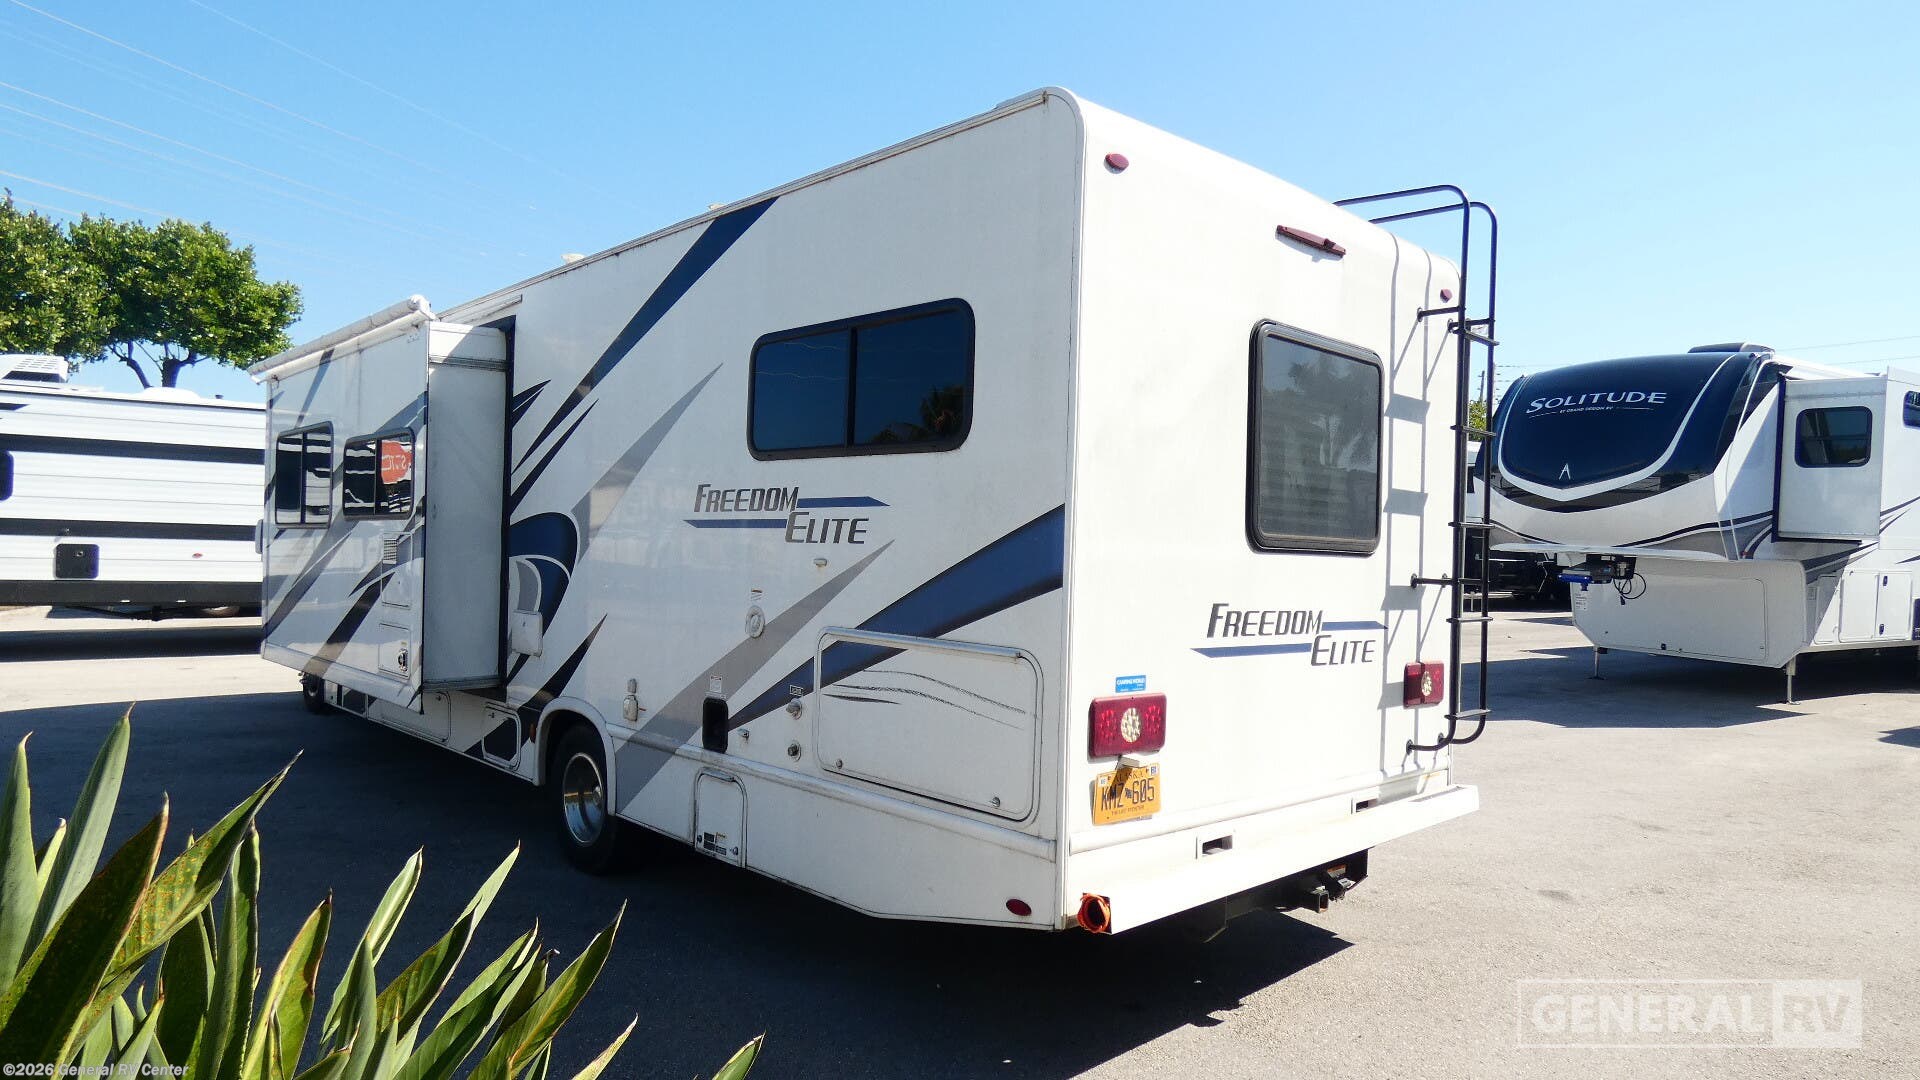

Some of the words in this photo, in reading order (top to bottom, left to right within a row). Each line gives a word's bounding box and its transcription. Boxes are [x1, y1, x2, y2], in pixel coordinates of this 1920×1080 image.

[1526, 391, 1667, 413] SOLITUDE
[694, 483, 799, 513] FREEDOM
[785, 511, 869, 544] ELITE
[1207, 603, 1324, 639] FREEDOM
[1311, 635, 1377, 666] ELITE
[1132, 777, 1155, 805] 605
